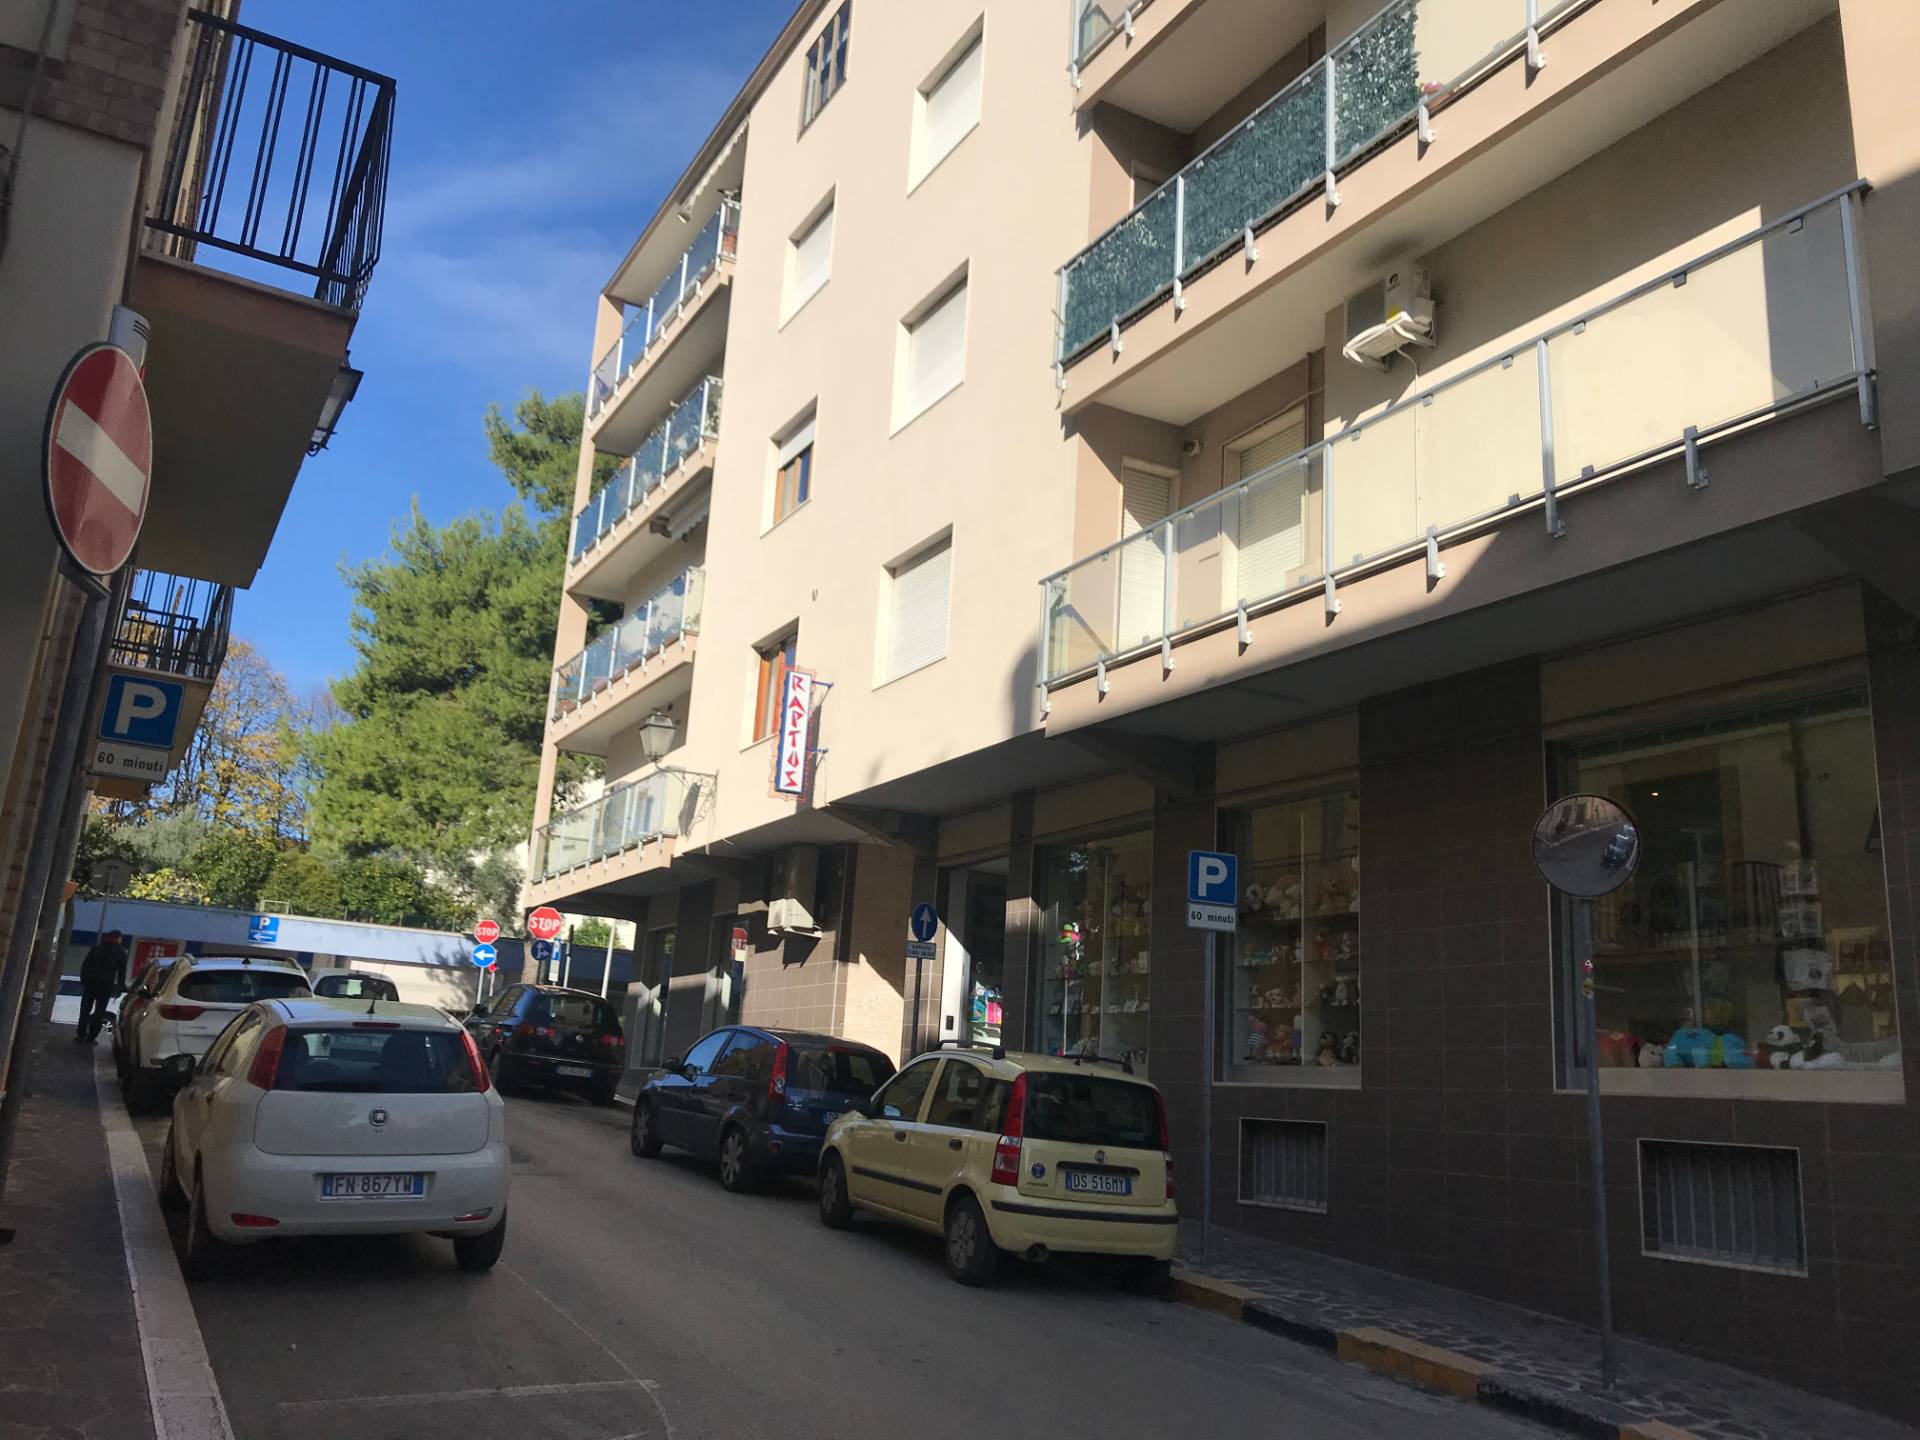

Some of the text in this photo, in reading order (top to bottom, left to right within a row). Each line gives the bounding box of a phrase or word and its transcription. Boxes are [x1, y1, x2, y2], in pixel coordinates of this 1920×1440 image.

[114, 681, 166, 735] P
[784, 675, 806, 787] RAPTUS
[97, 752, 163, 772] 60 minuti
[1198, 856, 1228, 897] P
[259, 917, 270, 929] P
[530, 916, 560, 932] STOP
[1191, 911, 1233, 923] 60 minuti
[477, 927, 498, 936] STOP
[334, 1175, 413, 1193] FN 867YW
[1073, 1175, 1124, 1192] DS 516MY
